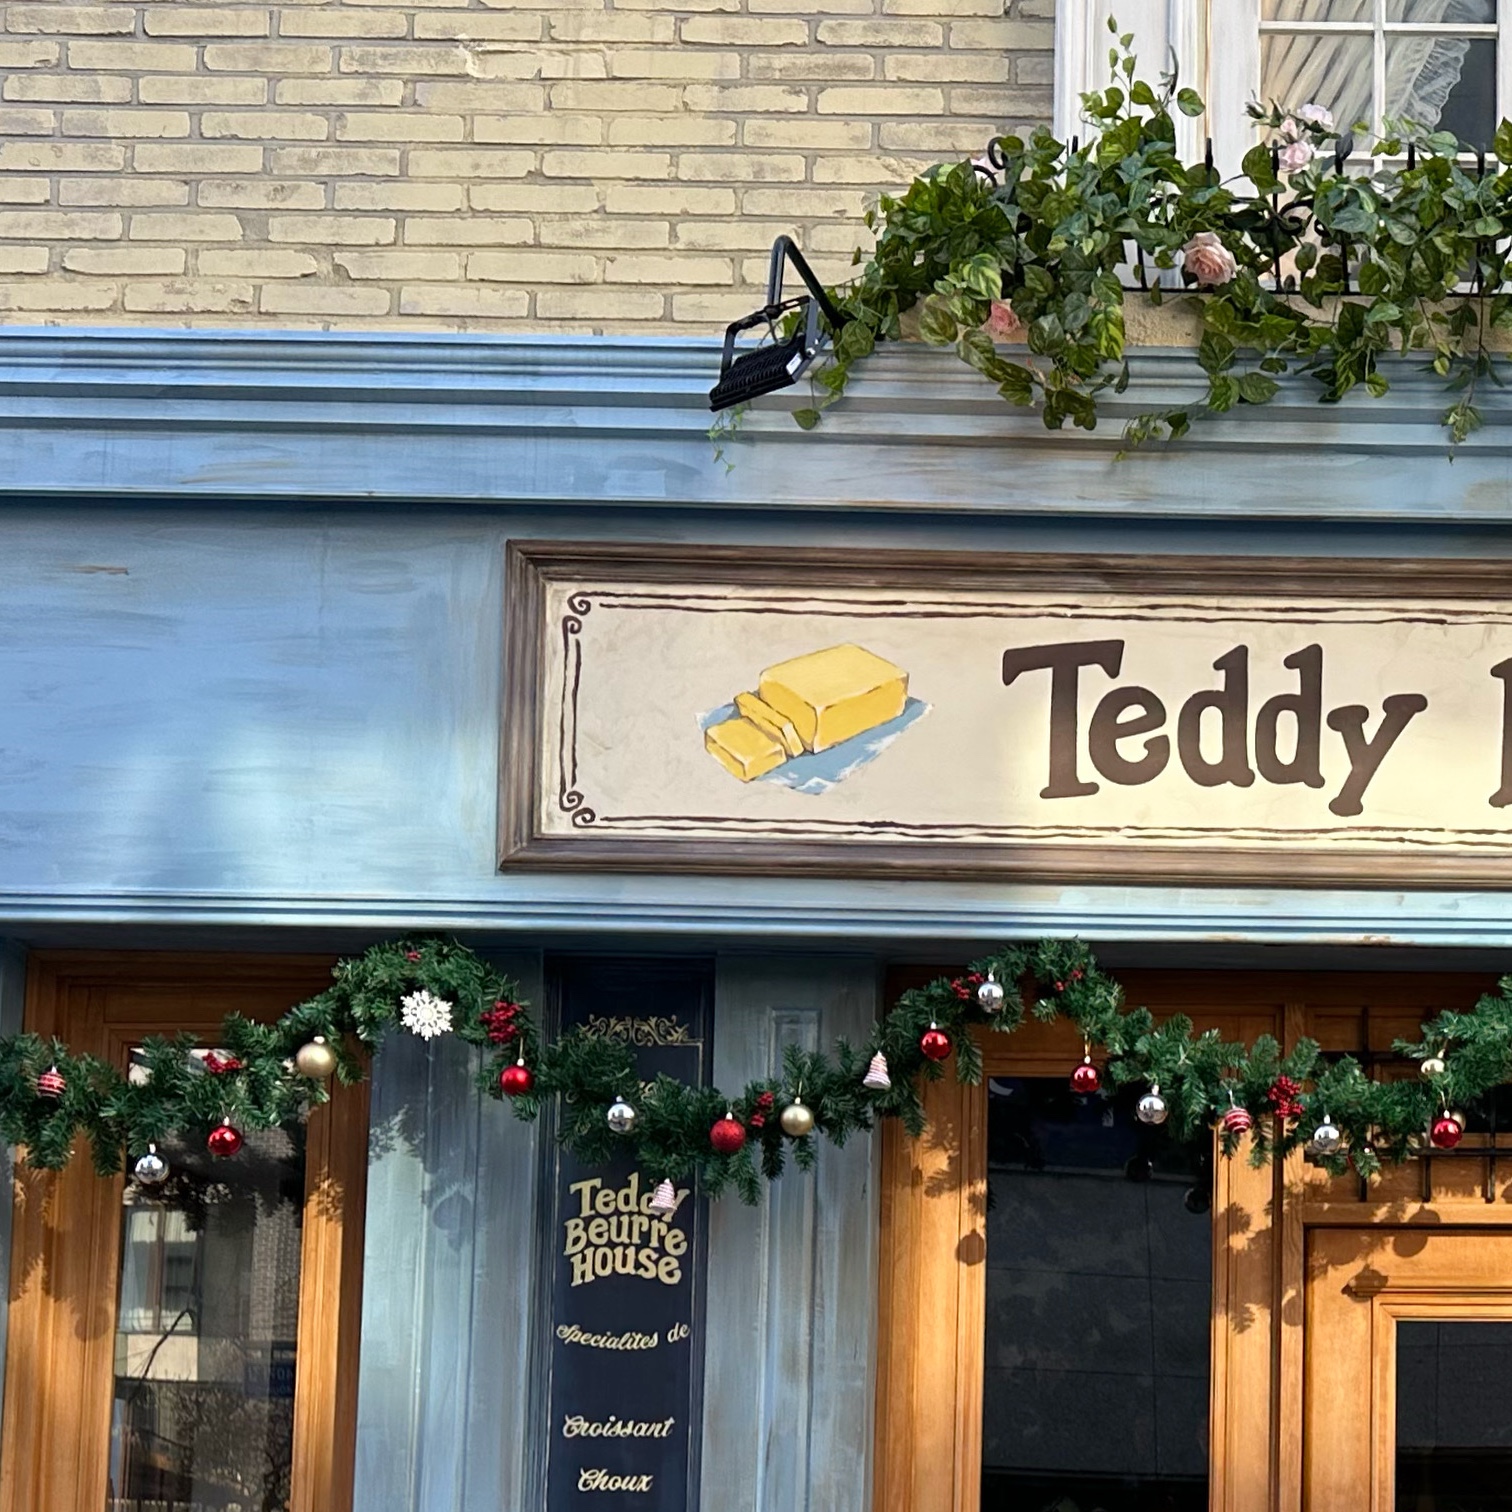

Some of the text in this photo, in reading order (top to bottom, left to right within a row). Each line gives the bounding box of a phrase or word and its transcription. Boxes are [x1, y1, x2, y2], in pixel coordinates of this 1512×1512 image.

[1003, 640, 1428, 817] Teddy
[563, 1214, 688, 1256] Beurre
[570, 1246, 682, 1287] House
[667, 1322, 691, 1343] de
[562, 1414, 675, 1438] Croissant
[577, 1467, 654, 1492] Choux
